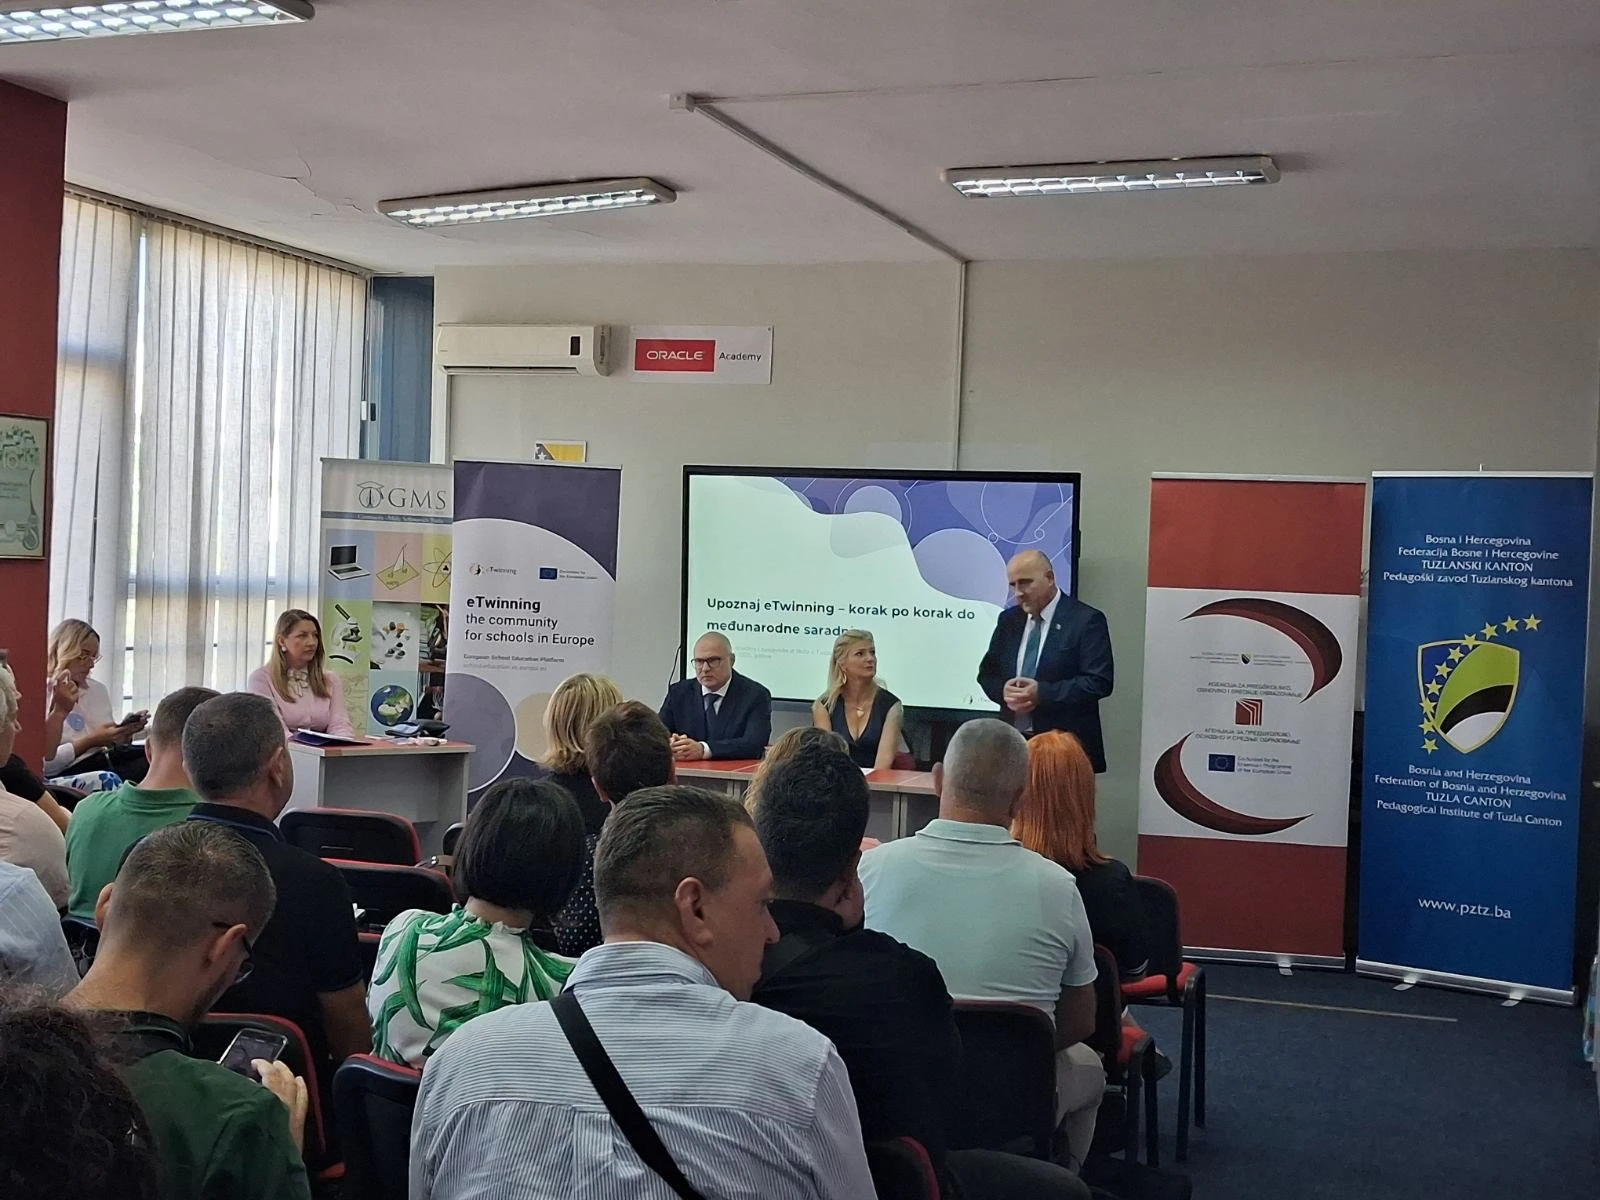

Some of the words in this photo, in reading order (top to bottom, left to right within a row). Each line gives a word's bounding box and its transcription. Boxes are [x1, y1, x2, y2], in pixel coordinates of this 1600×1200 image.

[646, 350, 704, 361] ORACLE
[718, 351, 762, 362] Academy
[388, 487, 447, 511] GMS
[1425, 534, 1456, 544] Bosna
[1465, 535, 1532, 547] Hercegovina
[1398, 547, 1448, 558] Federacija
[1451, 548, 1482, 558] Bosne
[1491, 549, 1560, 561] Hercegovine
[1421, 560, 1482, 570] TUZLANSKI
[1485, 562, 1533, 572] KANTON
[1383, 571, 1434, 583] Pedagoški
[1437, 574, 1468, 583] zavod
[1471, 574, 1528, 587] Tuzlanskog
[1530, 576, 1574, 587] kantona
[466, 596, 541, 613] eTwinning
[707, 597, 760, 612] Upoznaj
[763, 600, 834, 616] eTwinning
[848, 604, 888, 616] korak
[891, 607, 909, 619] po
[913, 606, 953, 619] korak
[957, 608, 976, 620] do
[466, 614, 485, 625] the
[488, 616, 558, 630] community
[706, 619, 801, 635] međunarodne
[465, 630, 483, 641] for
[486, 631, 534, 644] schools
[537, 633, 549, 645] in
[552, 633, 595, 647] Europe
[1408, 765, 1442, 776] Bosnia
[1444, 769, 1463, 778] and
[1466, 770, 1531, 785] Herzegovina
[1375, 774, 1426, 788] Federation
[1429, 779, 1440, 789] of
[1442, 781, 1475, 793] Bosnia
[1477, 784, 1497, 794] and
[1500, 786, 1567, 801] Herzegovina
[1425, 791, 1460, 804] TUZLA
[1463, 795, 1512, 809] CANTON
[1376, 800, 1437, 815] Pedagogical
[1439, 806, 1480, 819] Institute
[1483, 811, 1494, 820] of
[1496, 812, 1523, 823] Tuzla
[1525, 815, 1562, 827] Canton
[1418, 898, 1511, 919] www.pztz.ba
